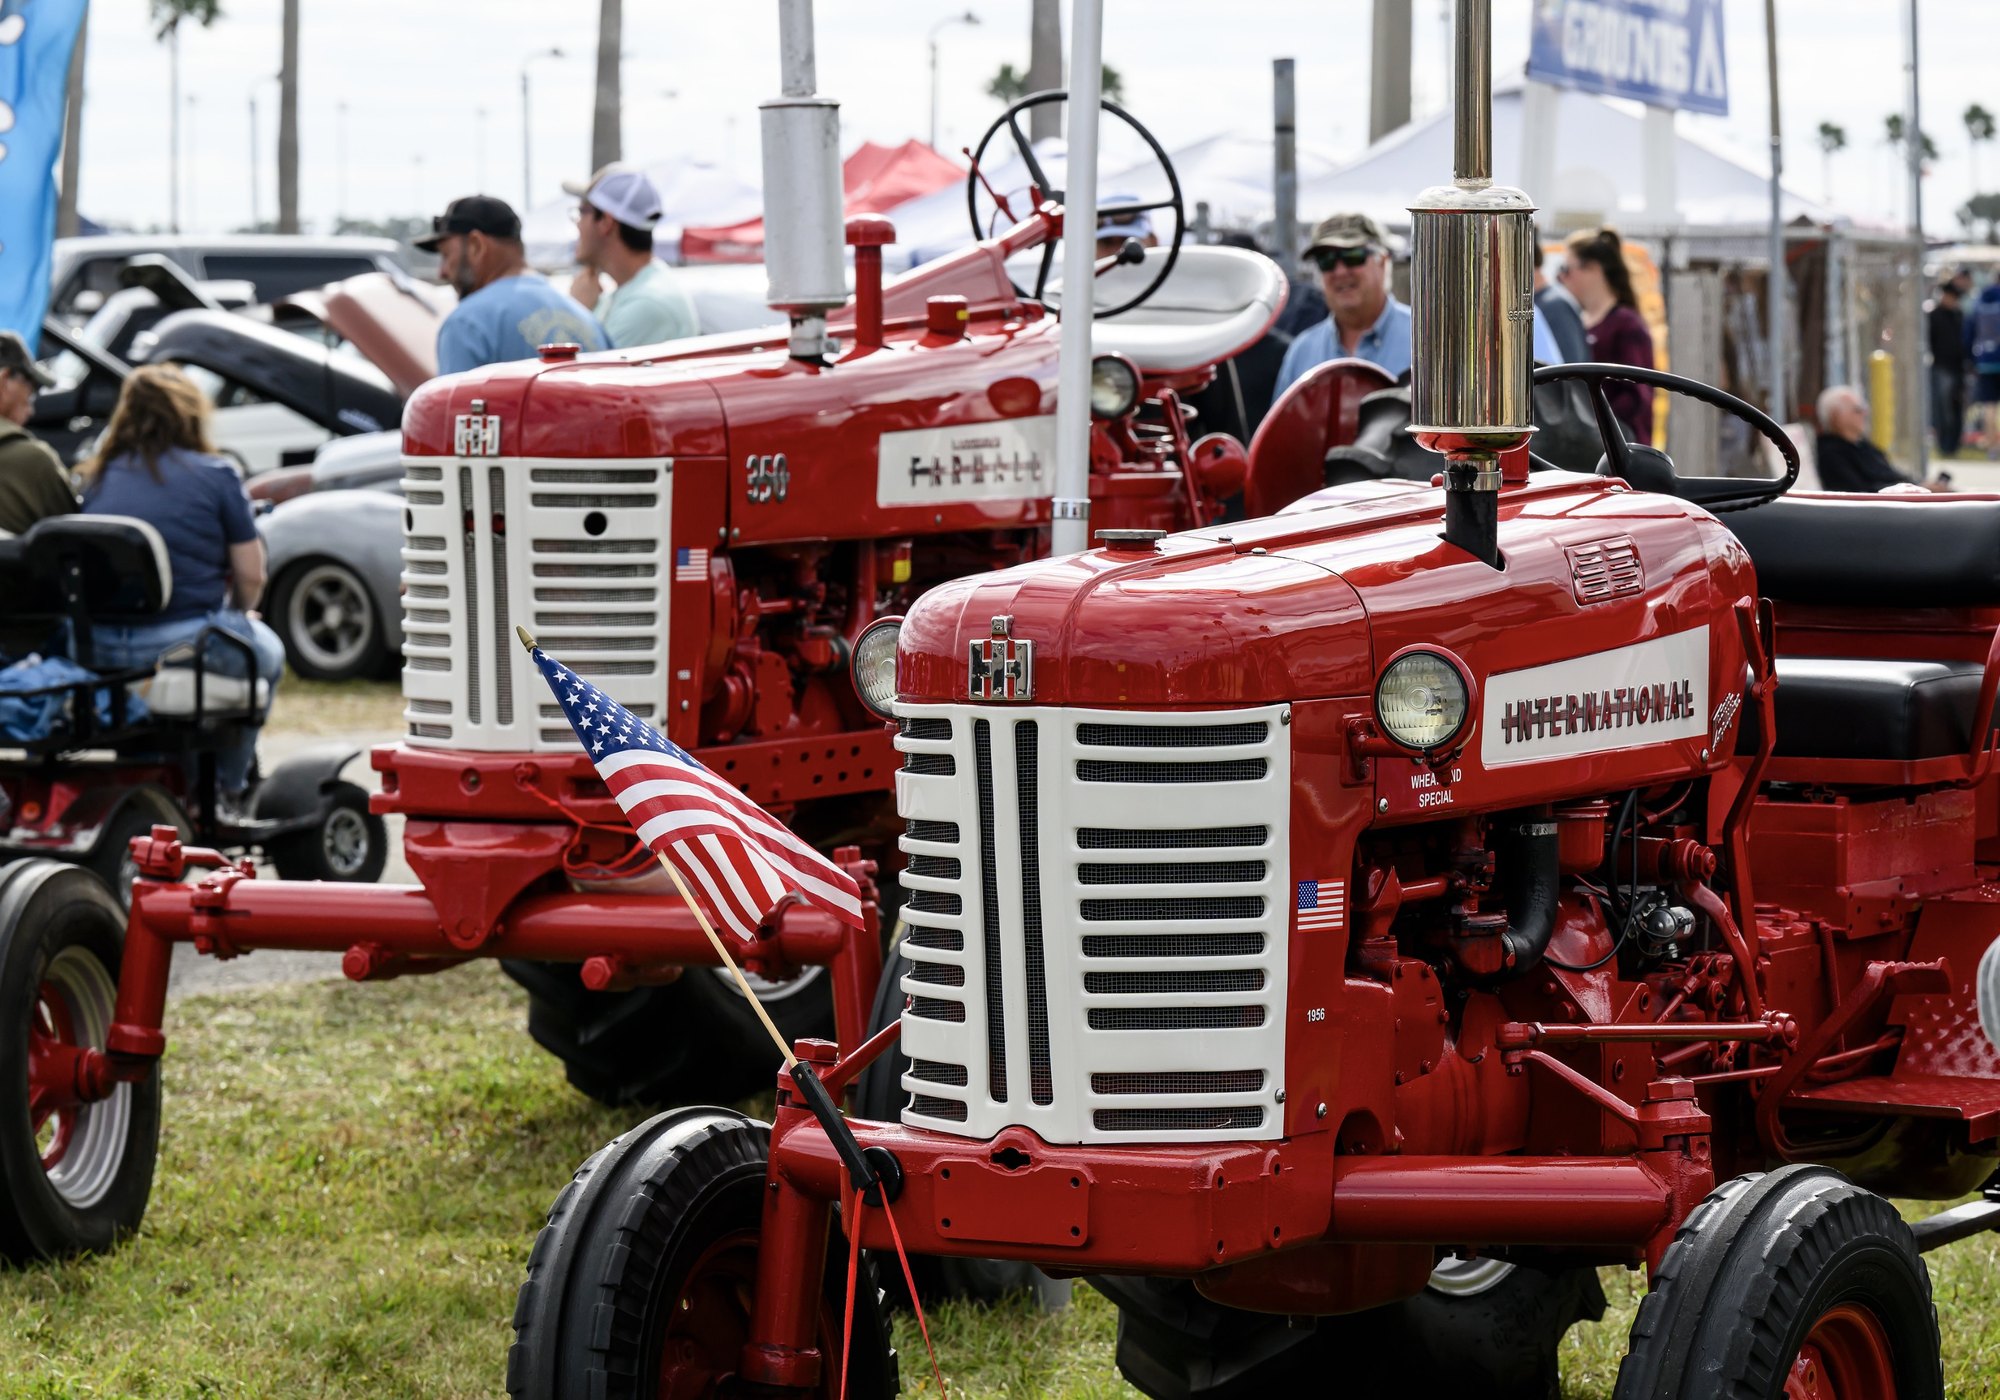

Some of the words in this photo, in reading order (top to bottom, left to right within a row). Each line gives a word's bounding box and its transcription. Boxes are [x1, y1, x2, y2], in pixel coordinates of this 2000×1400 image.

[1561, 0, 1692, 94] GROUNDS
[745, 452, 791, 503] 350
[908, 451, 1045, 488] FARMALL
[1501, 678, 1695, 744] INTERNATIONAL
[1410, 768, 1462, 789] WHEAND
[1419, 790, 1453, 808] SPECIAL
[1307, 1007, 1325, 1022] 1956
